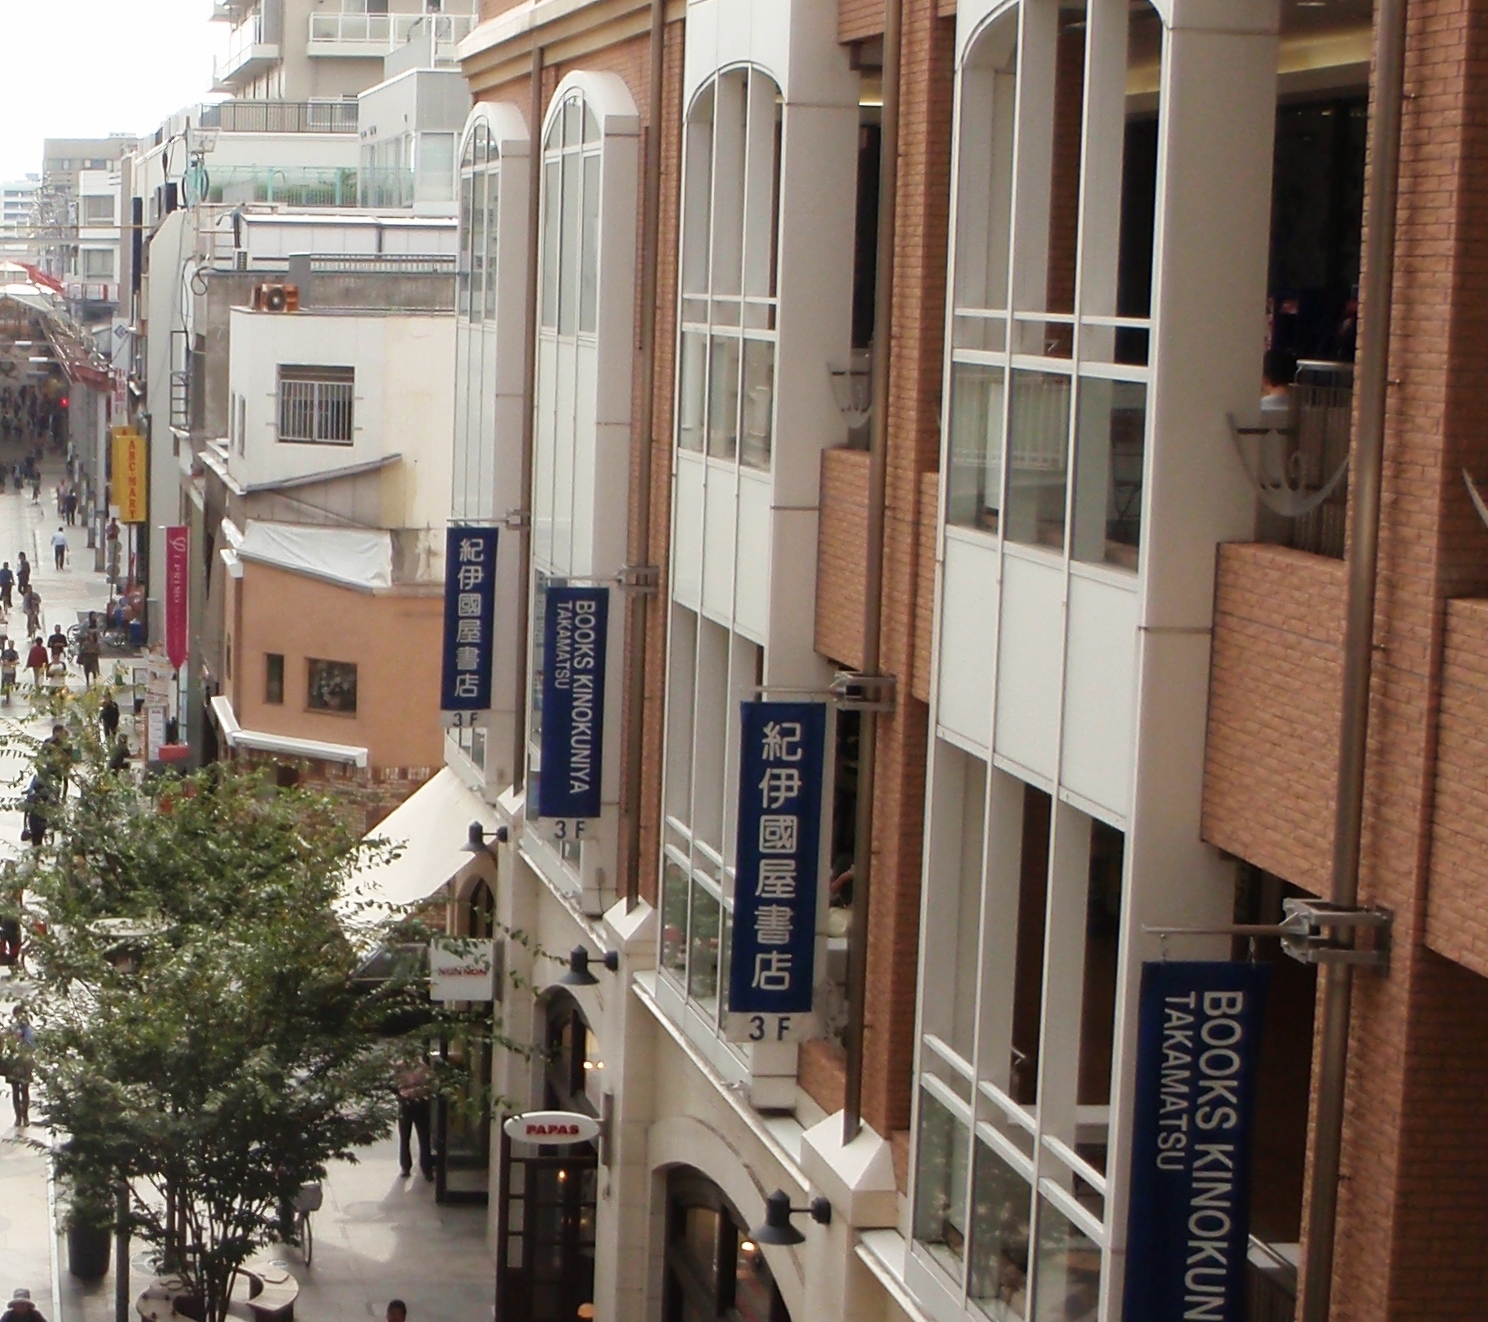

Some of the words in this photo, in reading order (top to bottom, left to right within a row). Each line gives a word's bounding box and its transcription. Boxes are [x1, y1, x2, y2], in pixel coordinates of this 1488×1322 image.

[454, 537, 485, 699] 紀伊國屋書店
[554, 600, 573, 690] TAKAMATSU
[573, 599, 596, 670] BOOKS
[569, 674, 594, 795] KINOKUNIYA
[751, 720, 803, 992] 紀伊國屋書店
[1156, 991, 1196, 1172] TAKAMATSU
[1193, 989, 1244, 1132] BOOKS
[525, 1124, 580, 1135] PAPAS
